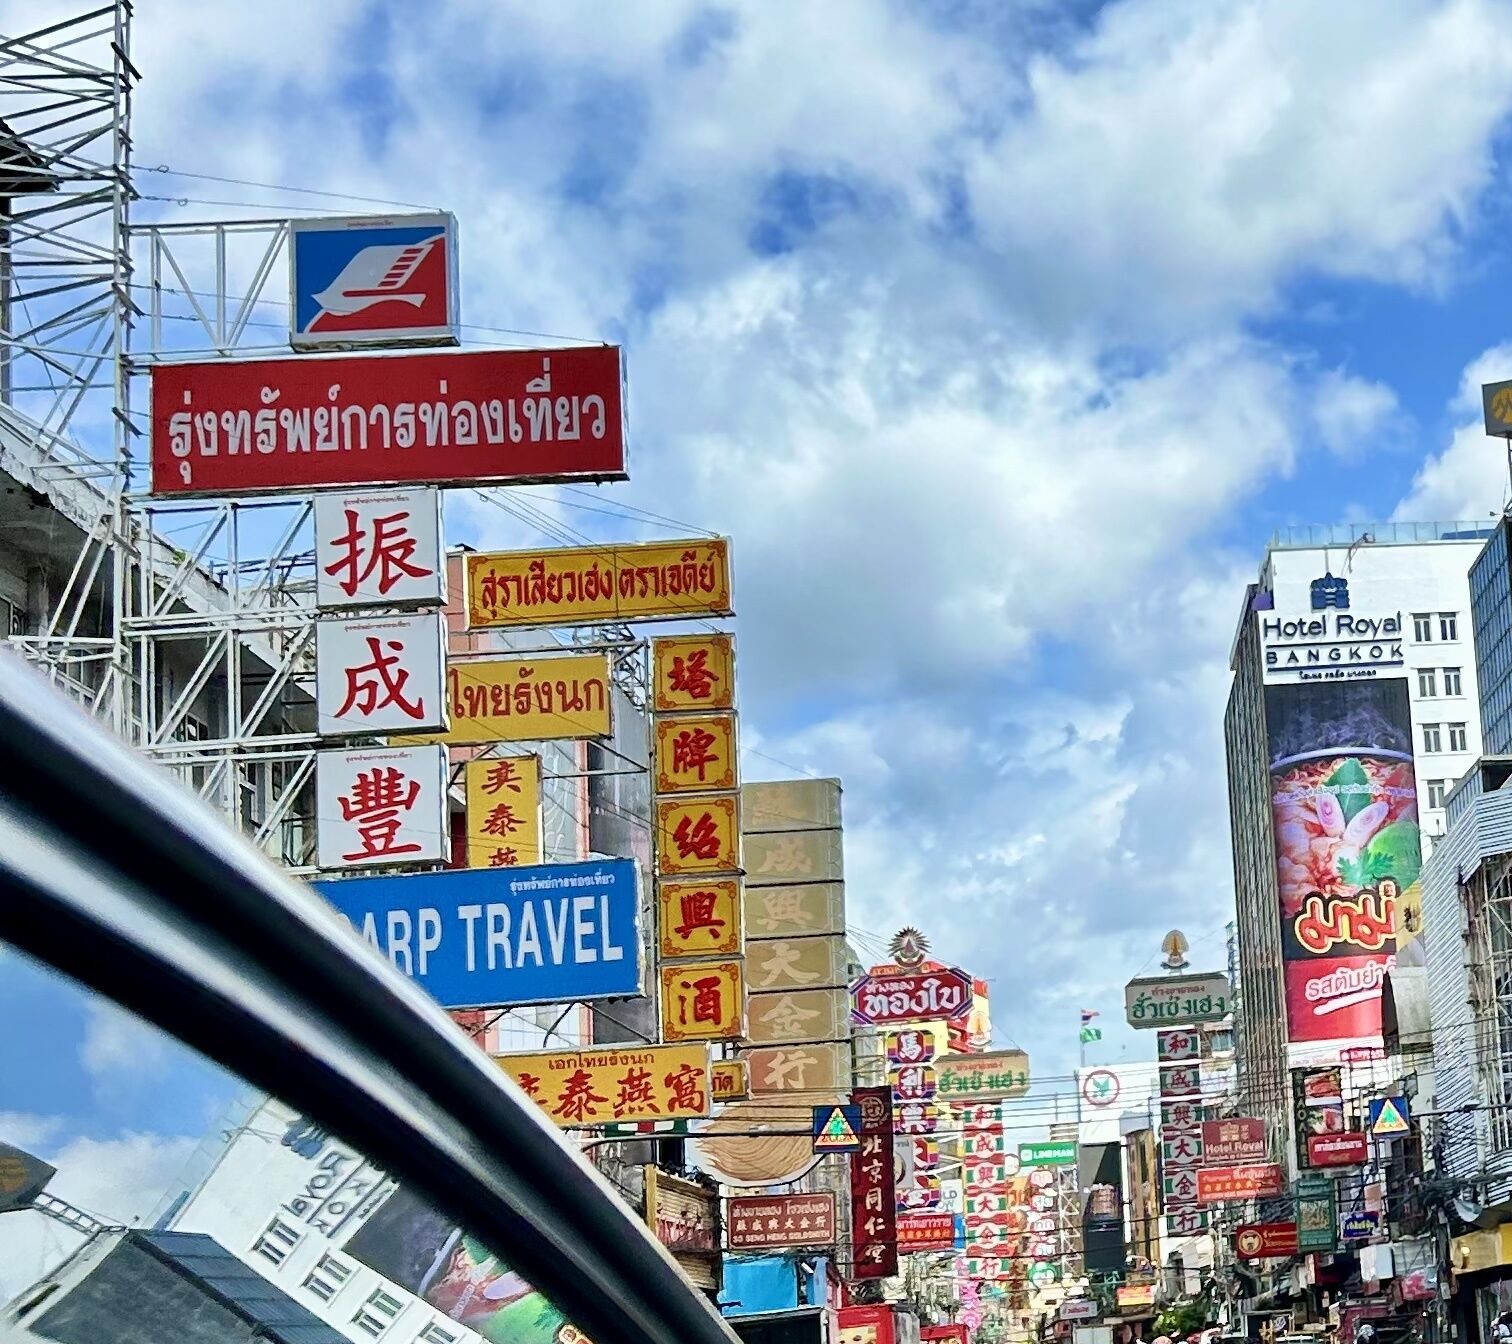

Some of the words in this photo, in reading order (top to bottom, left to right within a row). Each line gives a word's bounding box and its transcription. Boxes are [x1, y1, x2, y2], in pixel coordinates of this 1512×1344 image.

[168, 358, 606, 485] รุ่งทรัพย์การท่องเที่ยว
[1263, 613, 1327, 641] Hotel
[1336, 610, 1402, 643] Royal
[1265, 645, 1404, 666] BANGKOK
[340, 906, 442, 976] ARP
[456, 893, 625, 973] TRAVEL
